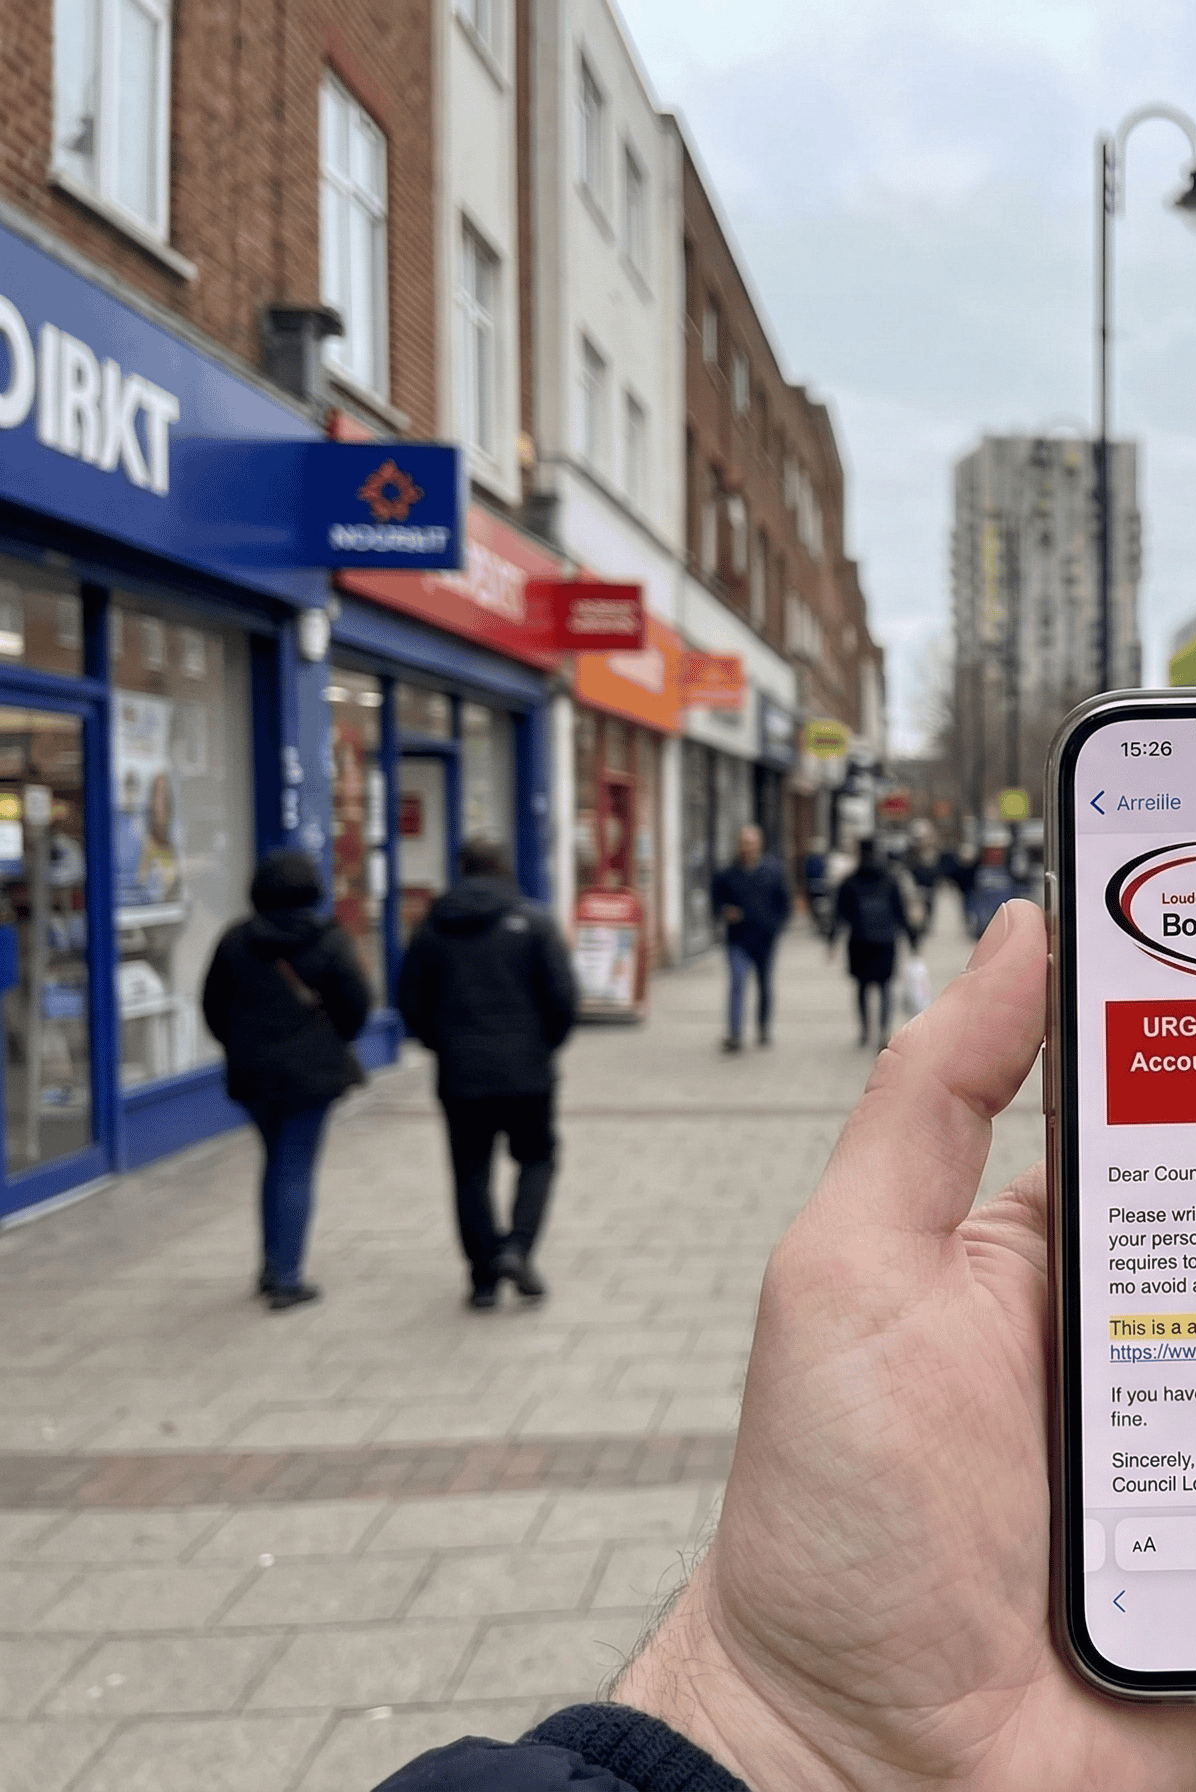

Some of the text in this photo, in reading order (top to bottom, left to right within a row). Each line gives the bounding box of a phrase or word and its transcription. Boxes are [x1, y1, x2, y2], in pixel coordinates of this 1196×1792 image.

[1120, 740, 1173, 758] 15:26
[1108, 1166, 1150, 1183] Dear
[1109, 1207, 1167, 1224] Please
[1108, 1234, 1147, 1252] your
[1109, 1253, 1178, 1275] requires
[1109, 1281, 1136, 1295] mo
[1140, 1276, 1187, 1295] avoid
[1109, 1319, 1146, 1336] This
[1151, 1318, 1166, 1336] is
[1170, 1321, 1182, 1335] a
[1111, 1386, 1122, 1403] If
[1126, 1389, 1158, 1407] you
[1110, 1410, 1148, 1427] fine.
[1111, 1450, 1195, 1472] Sincerely,
[1112, 1475, 1177, 1493] Council
